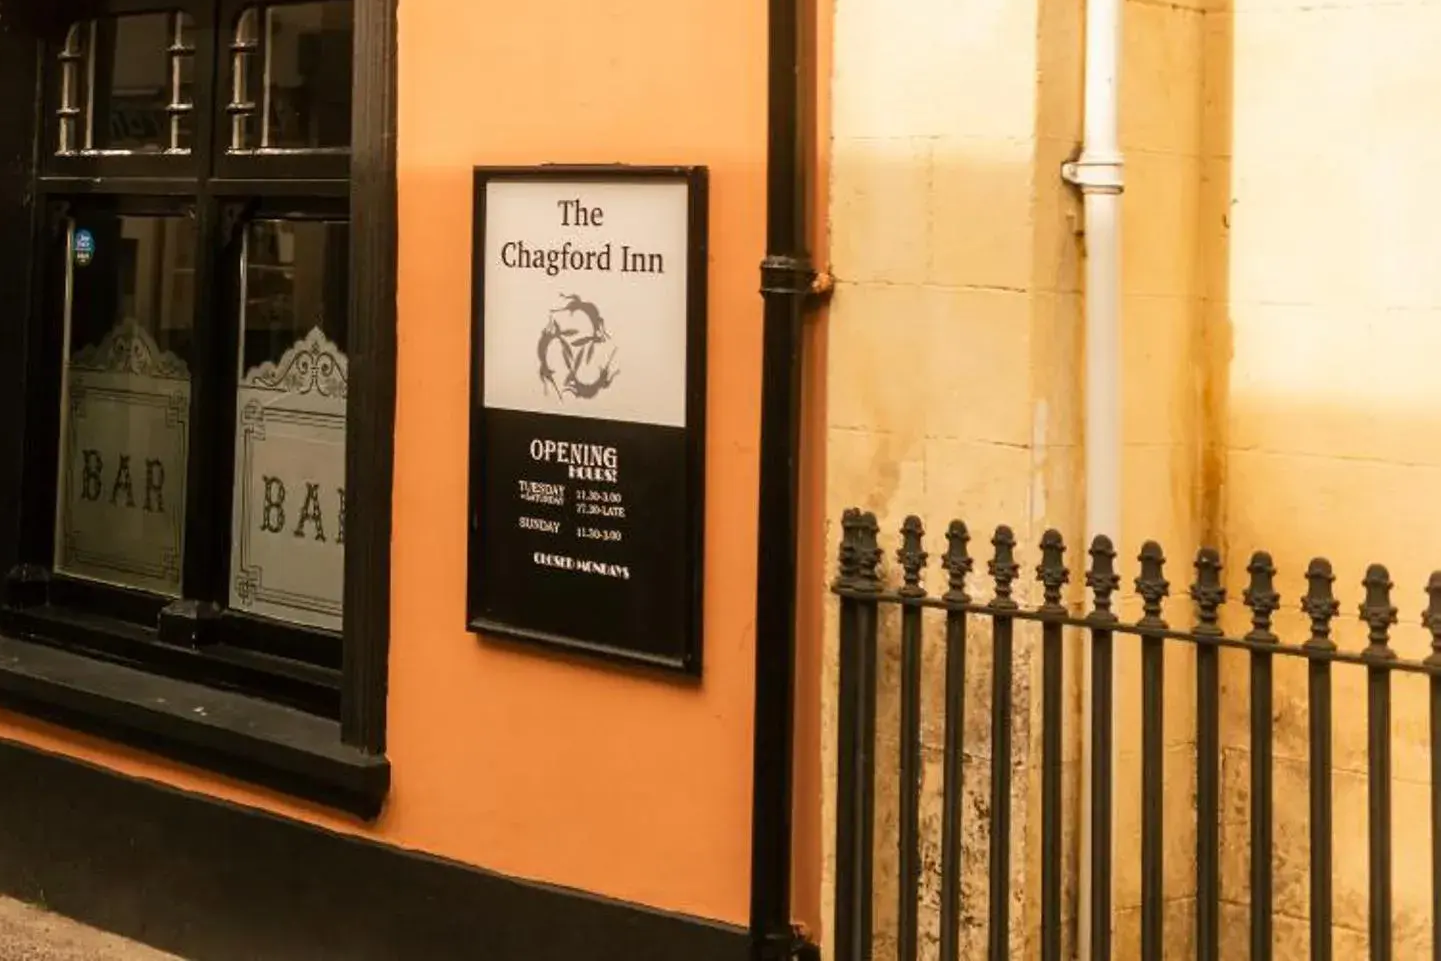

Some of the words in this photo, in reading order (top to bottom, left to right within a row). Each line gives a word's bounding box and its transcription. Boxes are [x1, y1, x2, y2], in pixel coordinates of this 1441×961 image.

[557, 198, 604, 227] The
[501, 240, 611, 276] Chagford
[621, 246, 665, 274] Inn
[530, 438, 618, 469] OPENING
[81, 448, 165, 514] BAR
[519, 480, 565, 496] TUESDAY
[519, 516, 561, 533] SUNDAY
[533, 551, 576, 570] CLOSED
[576, 559, 630, 580] MONDAYS
